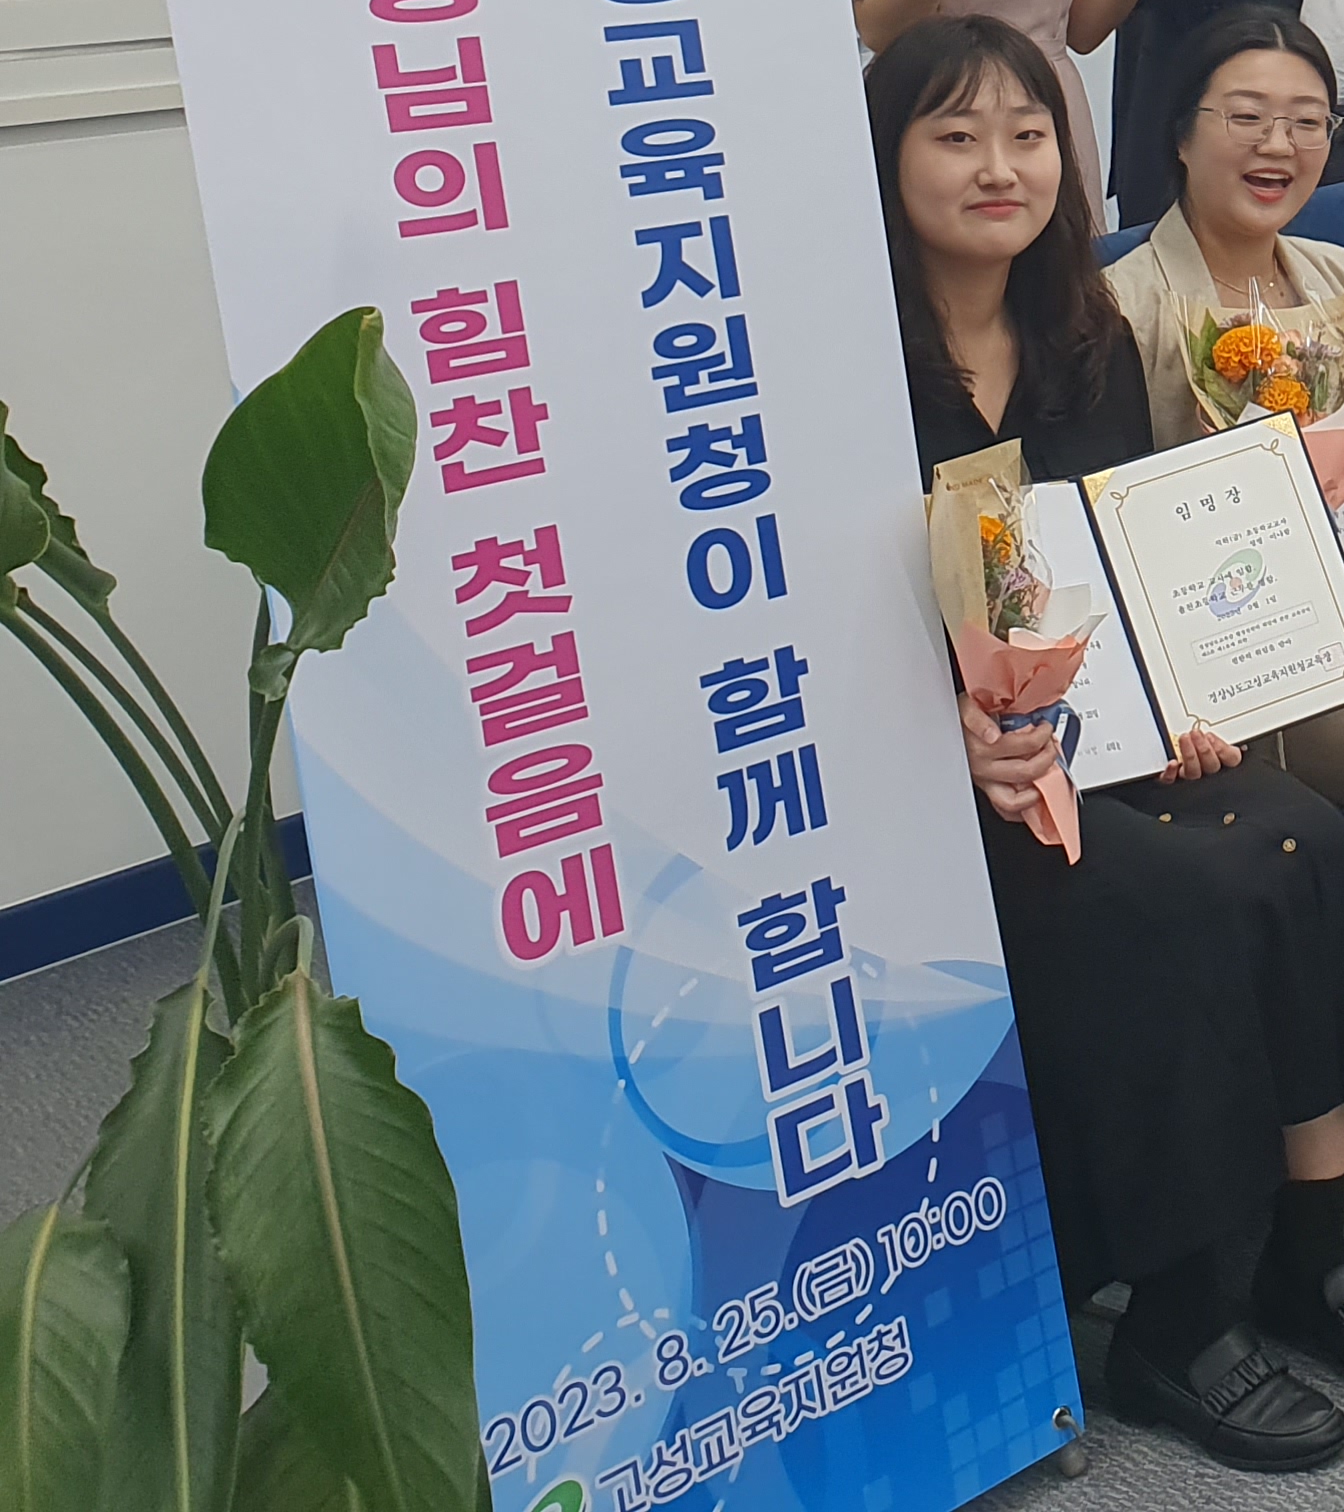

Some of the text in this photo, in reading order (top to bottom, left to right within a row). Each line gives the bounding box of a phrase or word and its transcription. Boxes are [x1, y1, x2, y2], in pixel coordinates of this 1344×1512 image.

[410, 279, 549, 495] 힘찬
[450, 523, 625, 961] 첫걸음에
[699, 644, 829, 852] 함께
[736, 875, 887, 1199] 합니다
[485, 1177, 1006, 1476] 2023. 8. 25.(금) 10:00
[597, 1315, 913, 1512] 고성교육지원청
